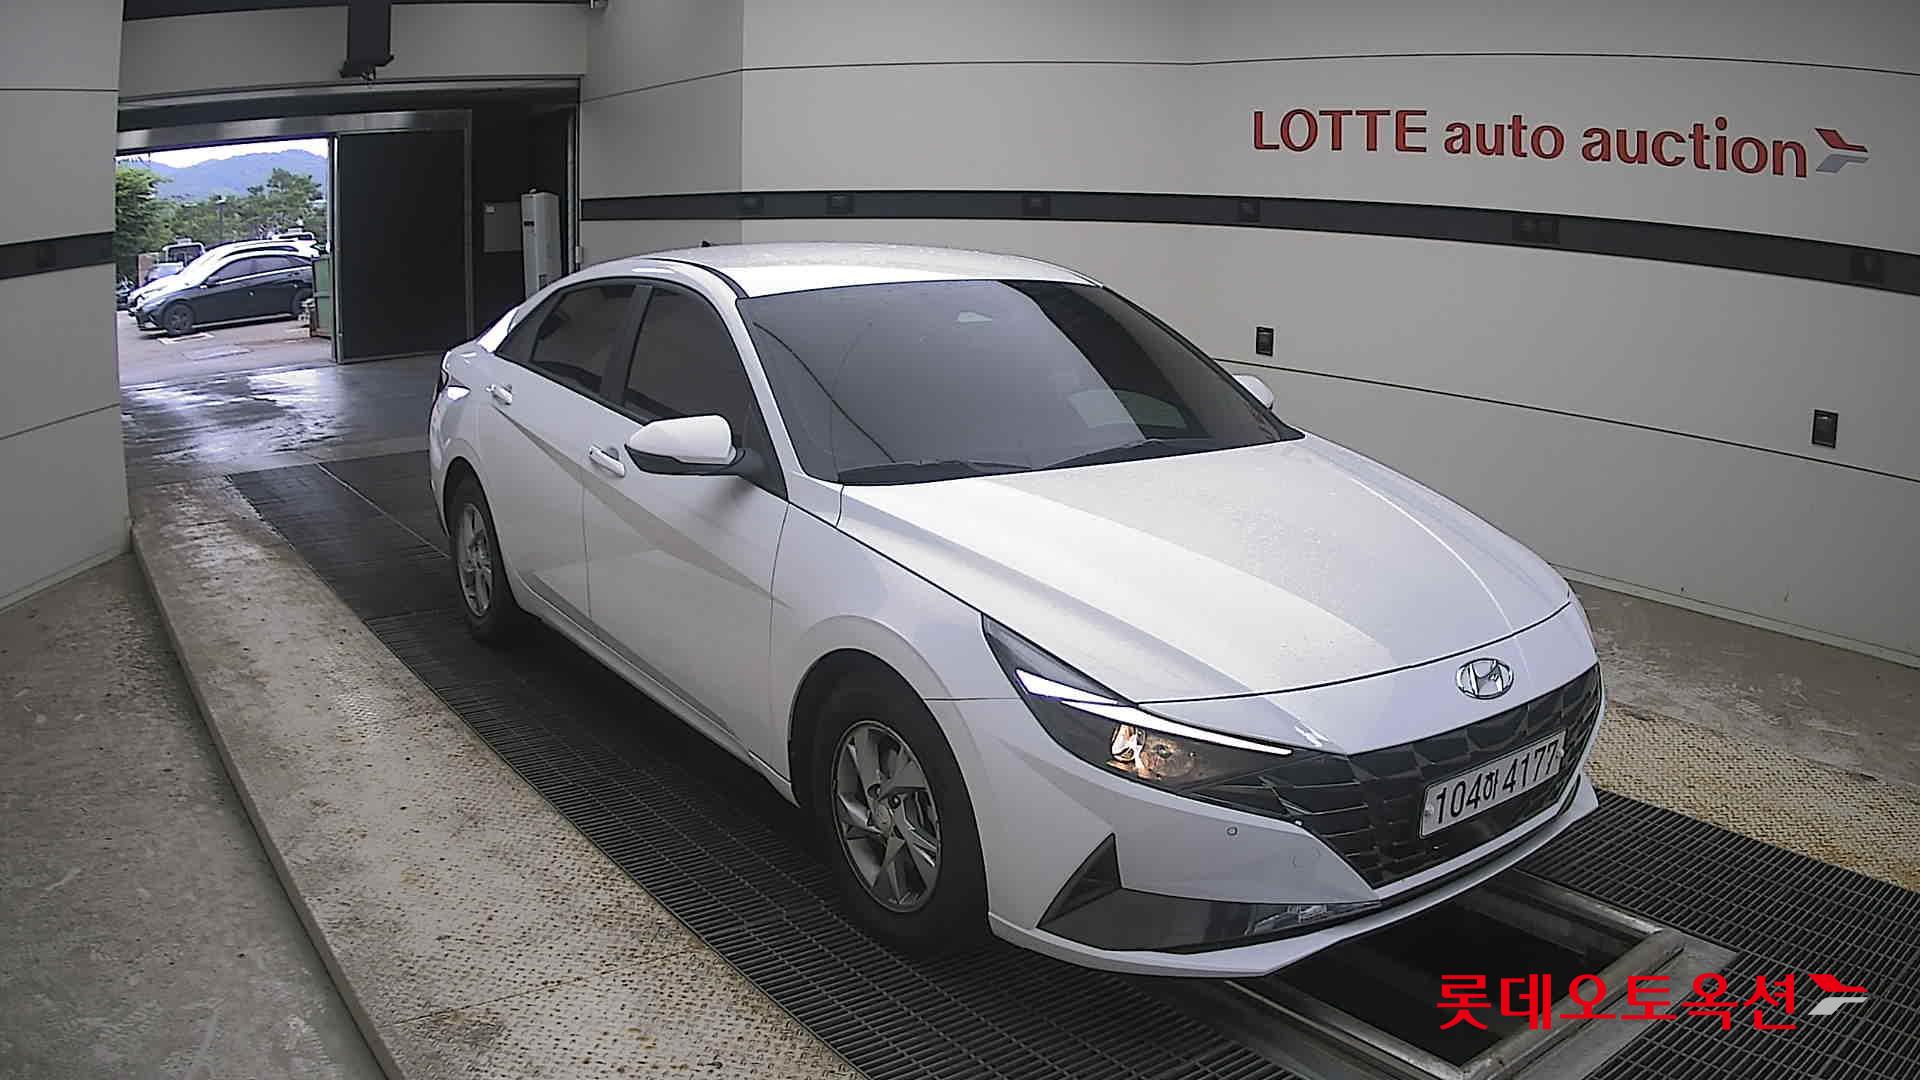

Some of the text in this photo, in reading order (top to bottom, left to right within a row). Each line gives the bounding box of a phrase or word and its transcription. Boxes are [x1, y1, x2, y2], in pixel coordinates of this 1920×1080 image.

[1252, 109, 1808, 178] LOTTE auto auction
[1502, 739, 1560, 793] 4177
